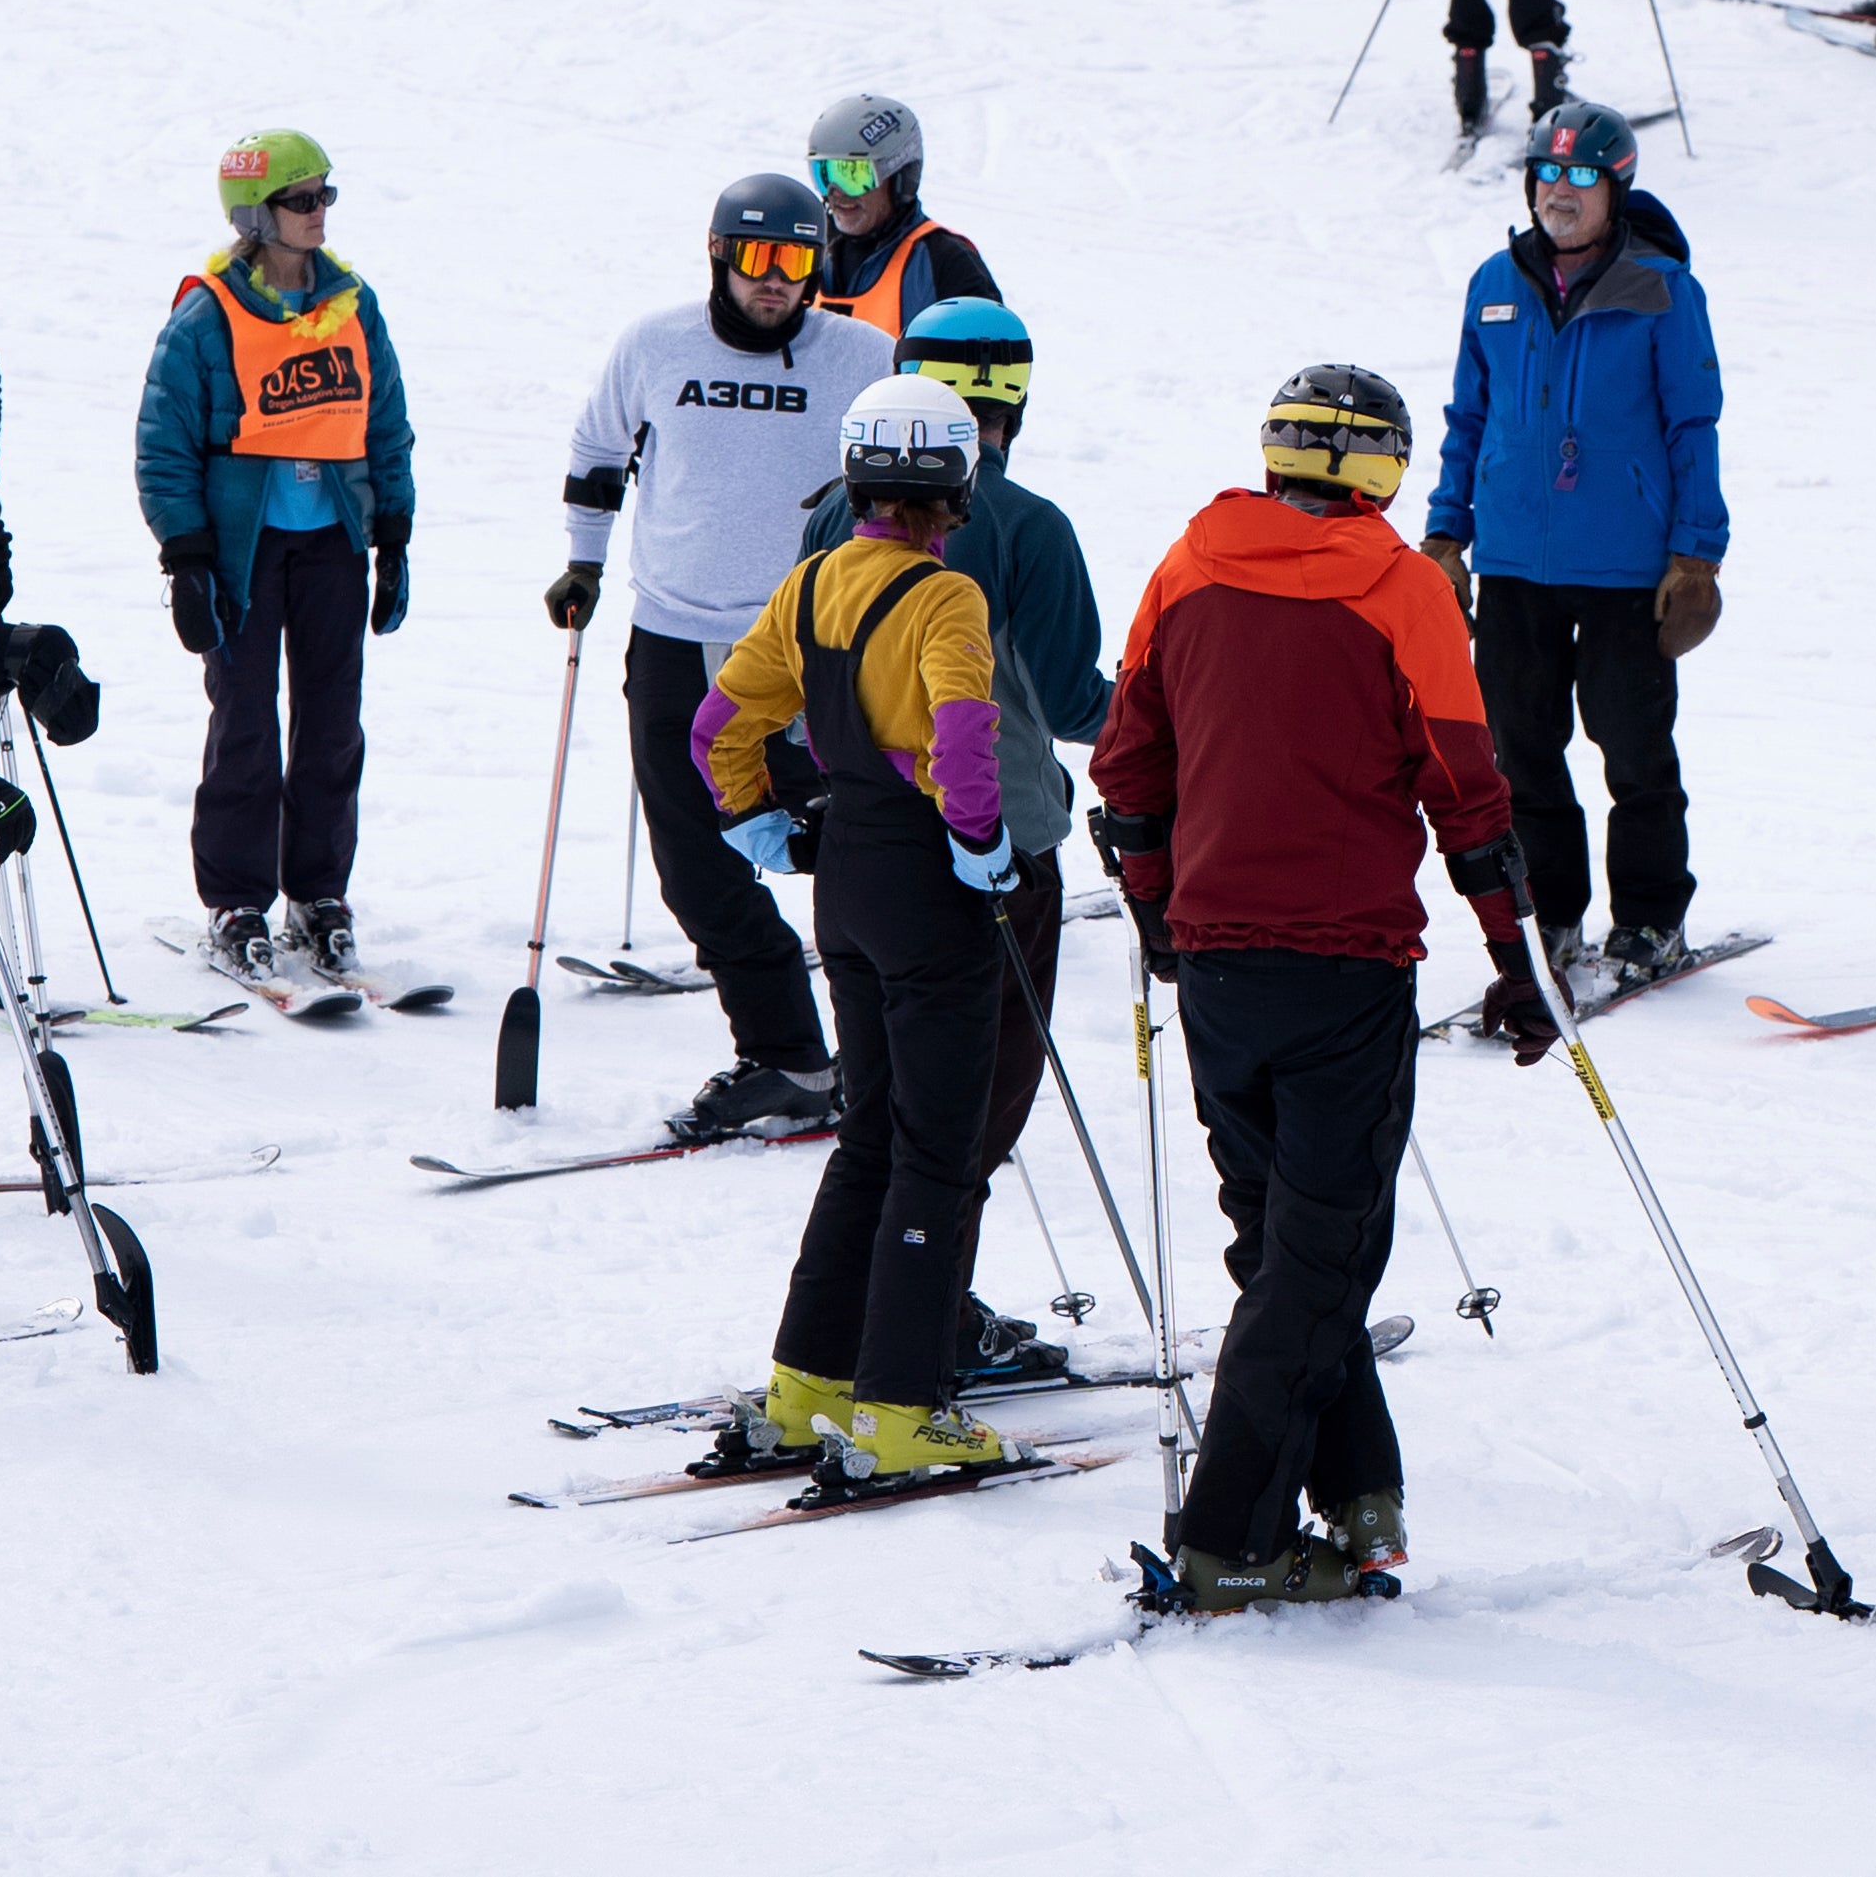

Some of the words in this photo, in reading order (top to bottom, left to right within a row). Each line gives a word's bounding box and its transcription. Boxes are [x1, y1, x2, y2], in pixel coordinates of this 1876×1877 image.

[862, 118, 887, 140] OAS
[266, 360, 322, 397] OAS
[268, 399, 295, 410] Oregon
[1135, 1004, 1149, 1077] SUPERLITE
[1569, 1046, 1608, 1121] SUPERLITE
[911, 1424, 986, 1451] FISCHER
